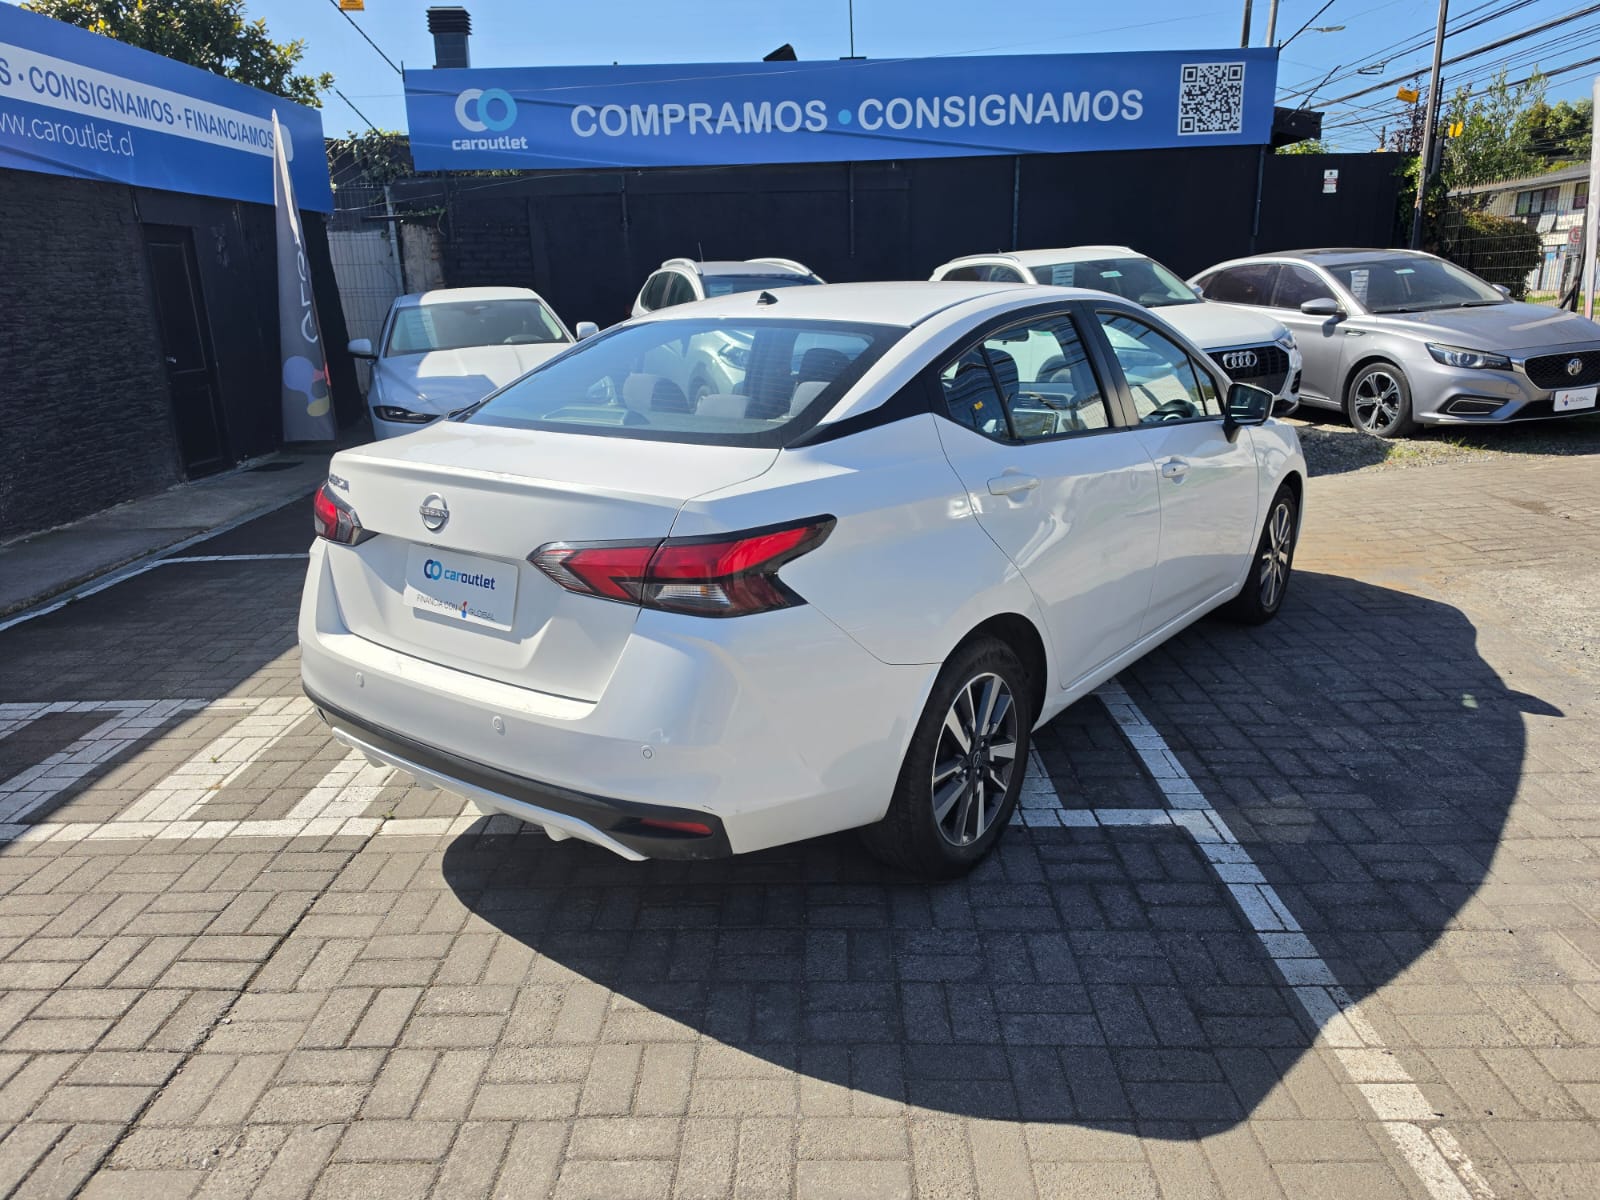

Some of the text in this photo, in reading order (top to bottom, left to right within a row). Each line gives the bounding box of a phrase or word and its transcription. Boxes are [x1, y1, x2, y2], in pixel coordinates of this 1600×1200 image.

[29, 66, 174, 125] CONSIGNAMOS
[184, 107, 274, 150] FINANCIAMOS
[571, 89, 1144, 137] COMPRAMOS CONSIGNAMOS
[452, 135, 529, 151] caroutlet
[444, 569, 496, 590] caroutlet
